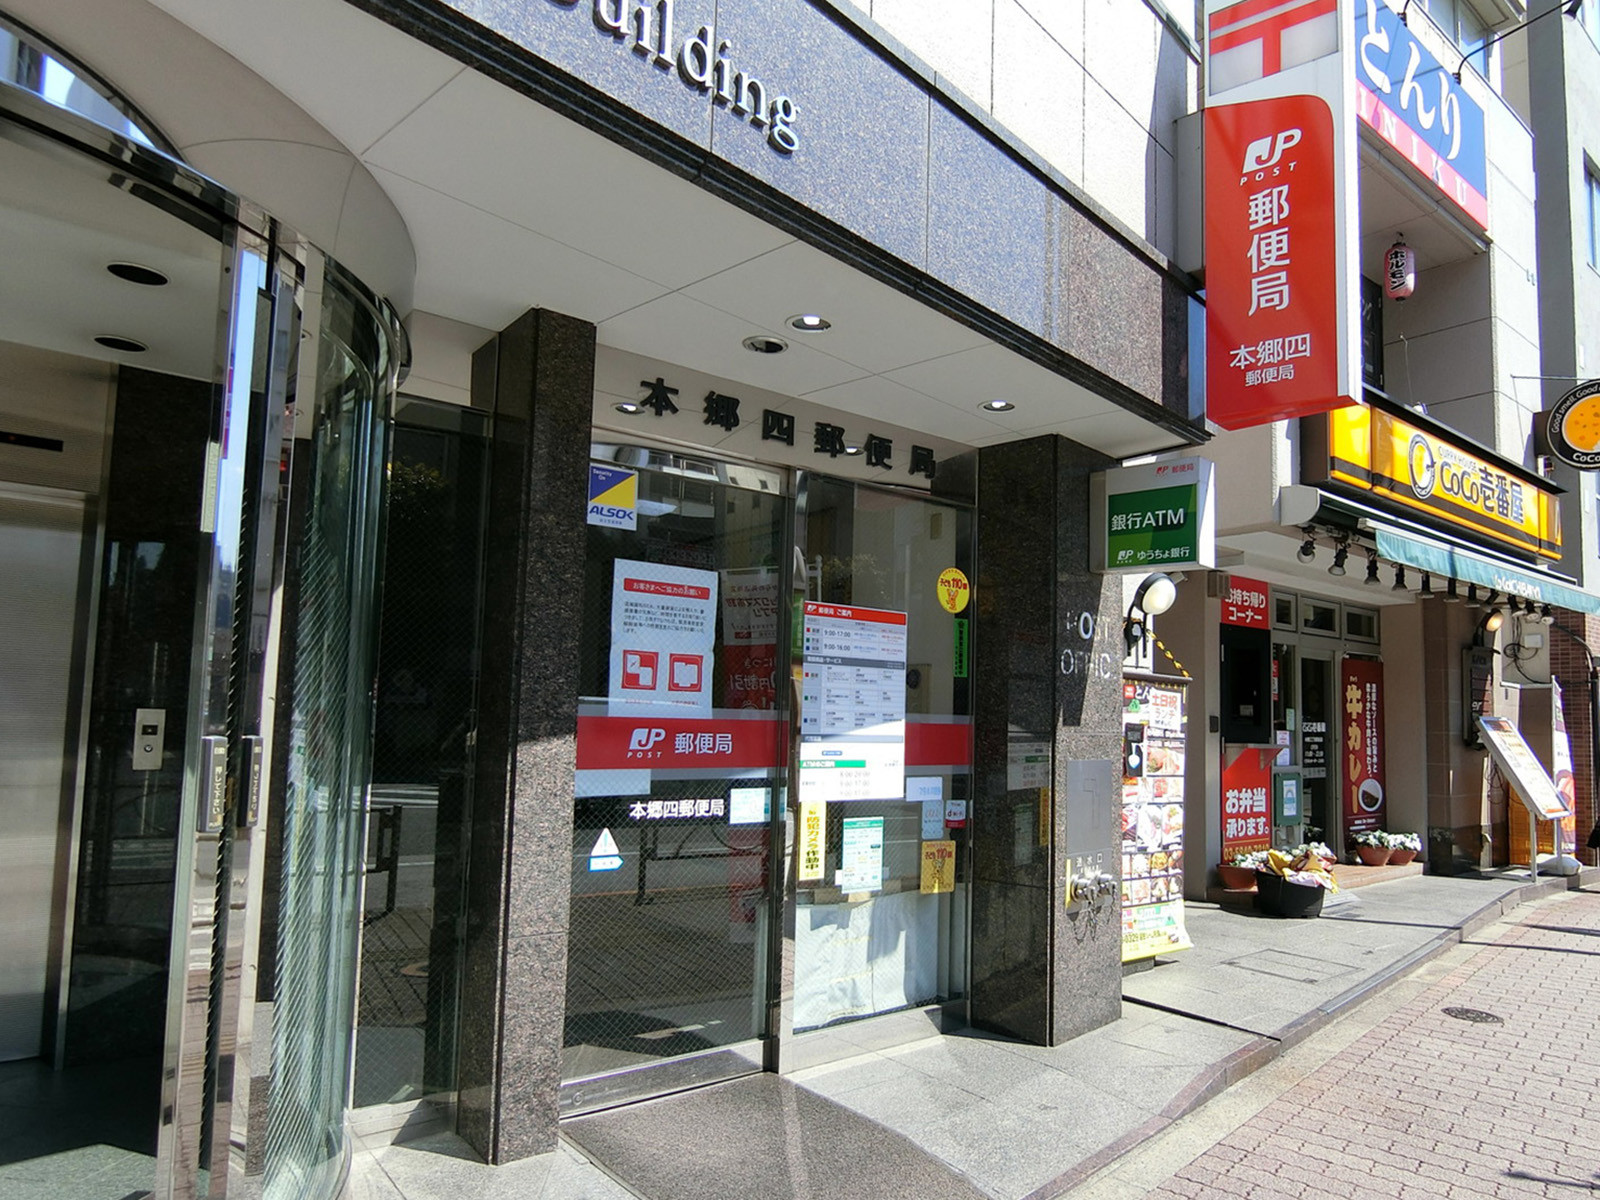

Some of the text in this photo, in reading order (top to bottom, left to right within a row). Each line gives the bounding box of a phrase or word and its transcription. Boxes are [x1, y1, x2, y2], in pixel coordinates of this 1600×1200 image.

[553, 0, 801, 152] uilding
[1239, 161, 1298, 186] POST
[1247, 184, 1291, 317] 郵便局
[1387, 249, 1408, 293] ホルモン
[1229, 333, 1311, 370] 本郷四
[1245, 363, 1295, 387] 郵便局
[640, 377, 936, 479] 本郷四郵便局
[1551, 413, 1562, 433] Good
[593, 469, 612, 477] Security
[1171, 463, 1195, 474] 郵便局
[1440, 460, 1524, 524] CoCo壱番屋
[589, 505, 634, 520] ALSOK
[1110, 508, 1185, 531] 銀行ATM
[1137, 546, 1190, 560] ゆうちょ銀行
[1228, 607, 1263, 623] コーナー
[824, 629, 851, 638] 9:00-17:00
[824, 643, 851, 651] 9:00-16:00
[1152, 694, 1178, 709] 土日祝
[1155, 708, 1176, 720] ランチ
[674, 733, 732, 754] 郵便局
[1345, 683, 1364, 815] 牛カレー
[629, 798, 725, 820] 本郷四郵便局
[1225, 787, 1267, 814] お弁当
[1226, 816, 1270, 838] 承ります。
